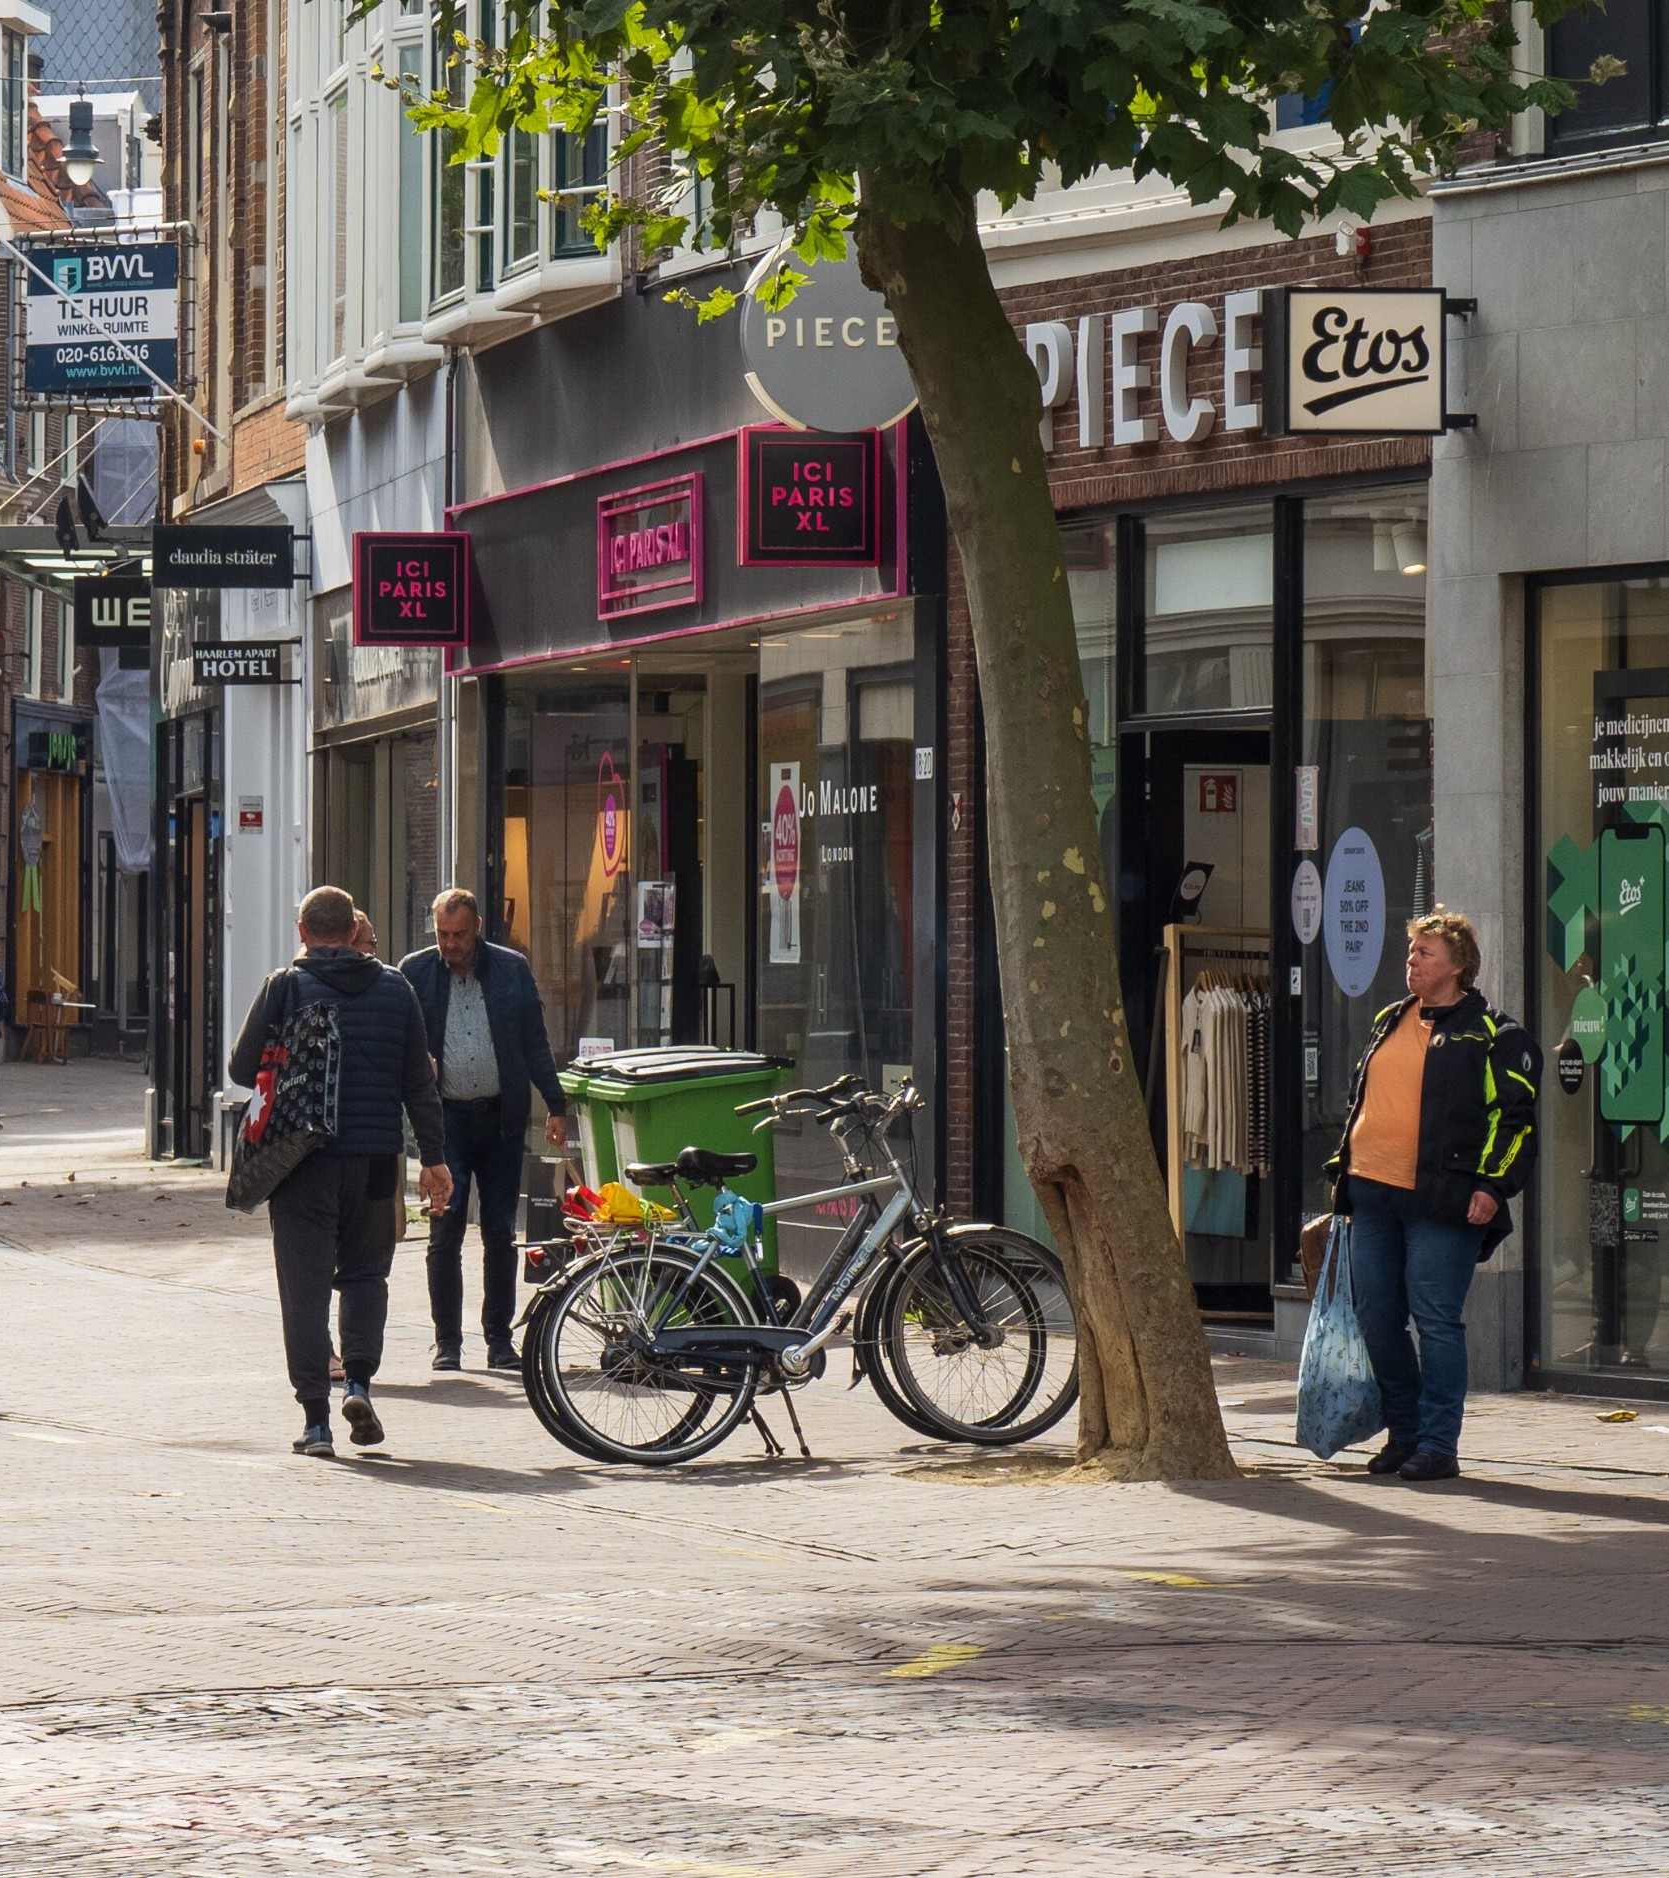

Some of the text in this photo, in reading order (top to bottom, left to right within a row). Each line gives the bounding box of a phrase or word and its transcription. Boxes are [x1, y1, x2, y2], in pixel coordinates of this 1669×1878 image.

[57, 296, 149, 319] TE HUUR
[57, 321, 149, 337] WINKELRUIMTE
[56, 344, 149, 363] 020-6161616
[1301, 306, 1430, 383] Etos
[793, 462, 833, 482] ICI
[771, 487, 854, 507] PARIS
[796, 511, 829, 531] XL
[170, 548, 277, 566] claudia sträter
[630, 526, 669, 569] PARIS
[396, 561, 429, 577] ICI
[379, 581, 446, 598] PARIS
[92, 597, 150, 626] WE
[399, 601, 427, 618] XL
[195, 649, 277, 659] HAARLEM APART
[202, 660, 272, 677] HOTEL
[1593, 713, 1669, 742] je medicijnen
[1589, 746, 1647, 773] makkelijk
[1648, 751, 1662, 768] en
[1596, 781, 1669, 808] jouw manier
[776, 814, 796, 846] 40%
[1344, 880, 1366, 893] JEANS
[1340, 900, 1369, 913] 50% OFF
[1340, 920, 1369, 933] THE 2ND
[1574, 1016, 1605, 1033] nieuw!
[277, 1073, 308, 1094] Couture
